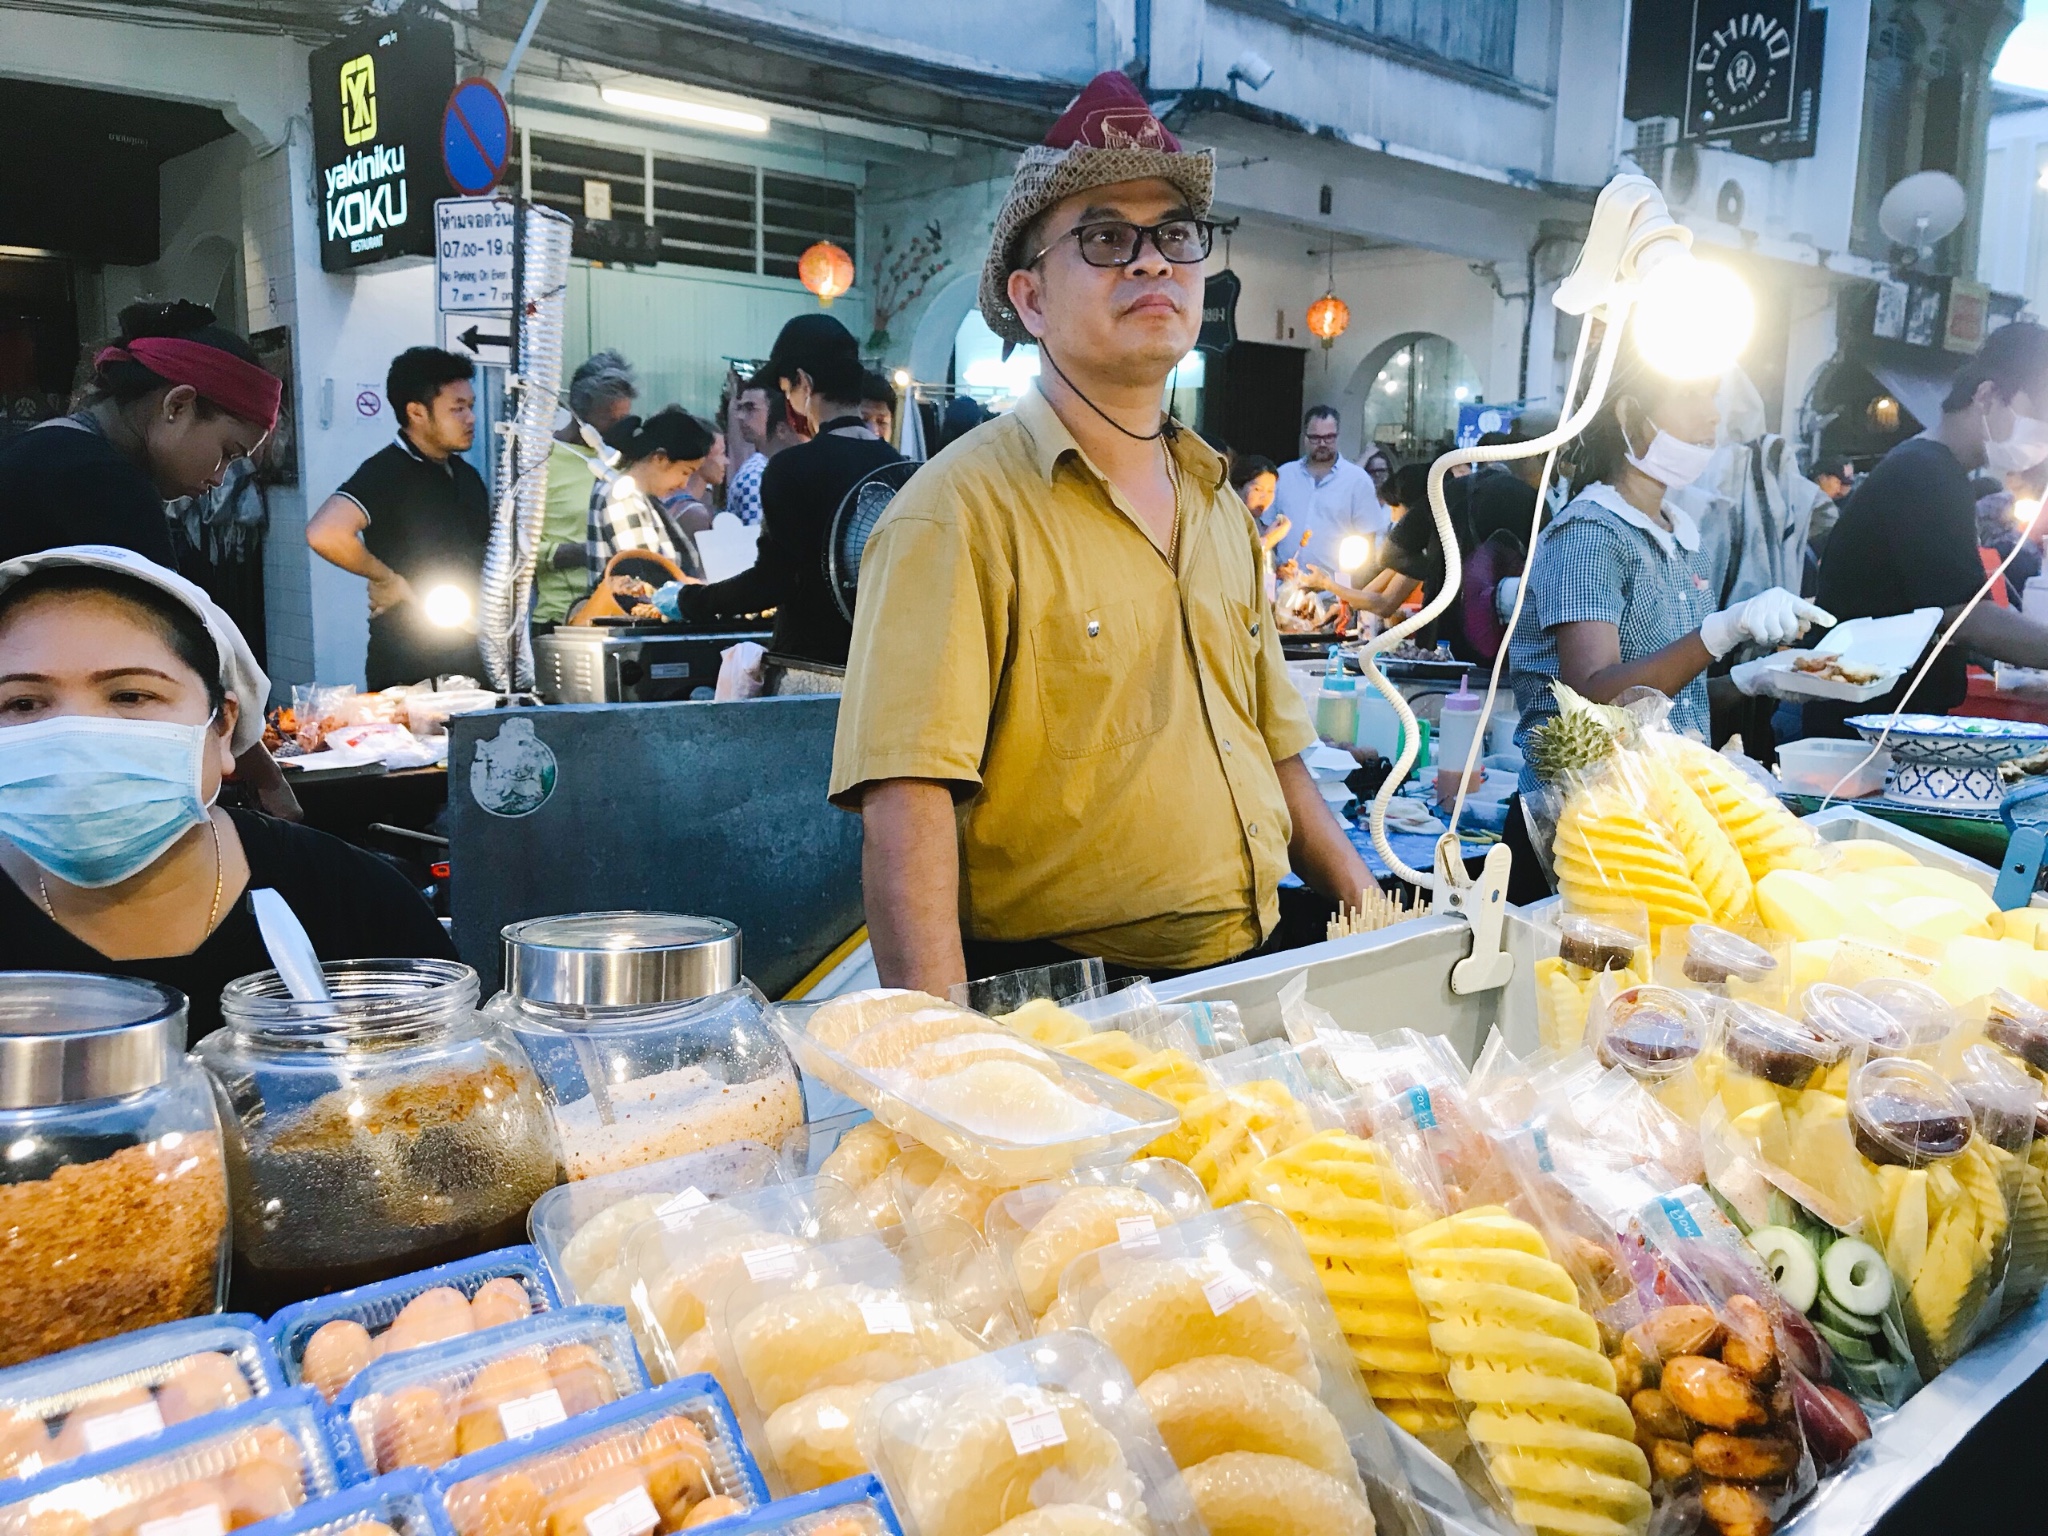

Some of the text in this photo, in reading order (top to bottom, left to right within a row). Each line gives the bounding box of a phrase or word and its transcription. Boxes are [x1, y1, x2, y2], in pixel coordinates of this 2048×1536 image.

[324, 144, 405, 199] yakiniku
[326, 178, 407, 241] KOKU
[454, 270, 477, 283] Parking
[452, 288, 459, 301] 7
[490, 287, 497, 300] 7
